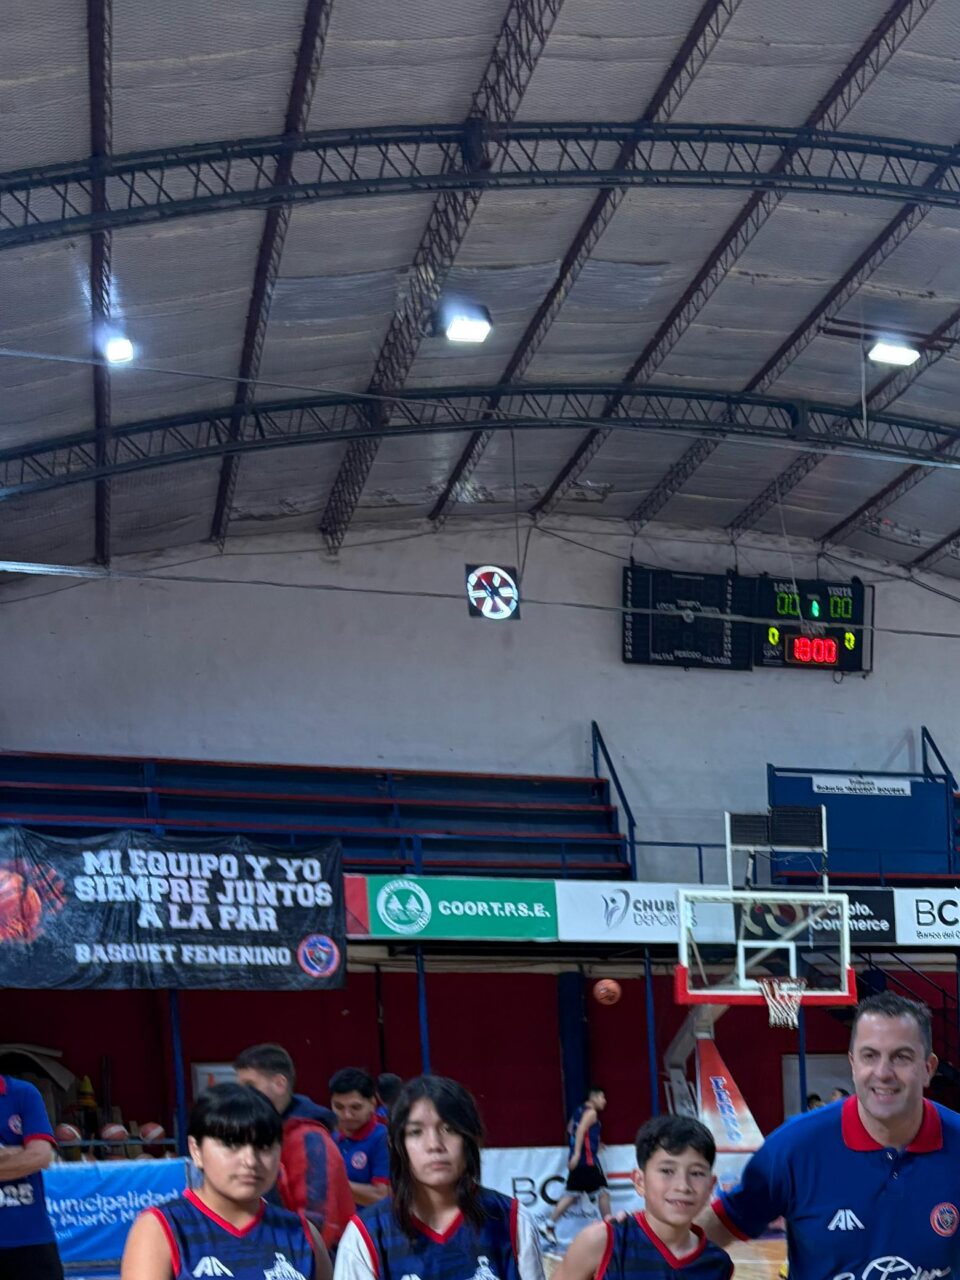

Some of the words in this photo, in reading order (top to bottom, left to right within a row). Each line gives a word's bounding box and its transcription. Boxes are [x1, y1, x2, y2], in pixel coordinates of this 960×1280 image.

[82, 850, 122, 875] MI
[129, 849, 240, 879] EQUIPO
[245, 854, 272, 880] Y
[277, 857, 322, 882] YO
[74, 875, 210, 904] SIEMPRE
[217, 879, 333, 907] JUNTOS
[137, 902, 163, 929] A
[168, 903, 214, 930] LA
[218, 905, 279, 932] PAR
[74, 943, 177, 964] BASQUET
[181, 944, 292, 966] FEMENINO
